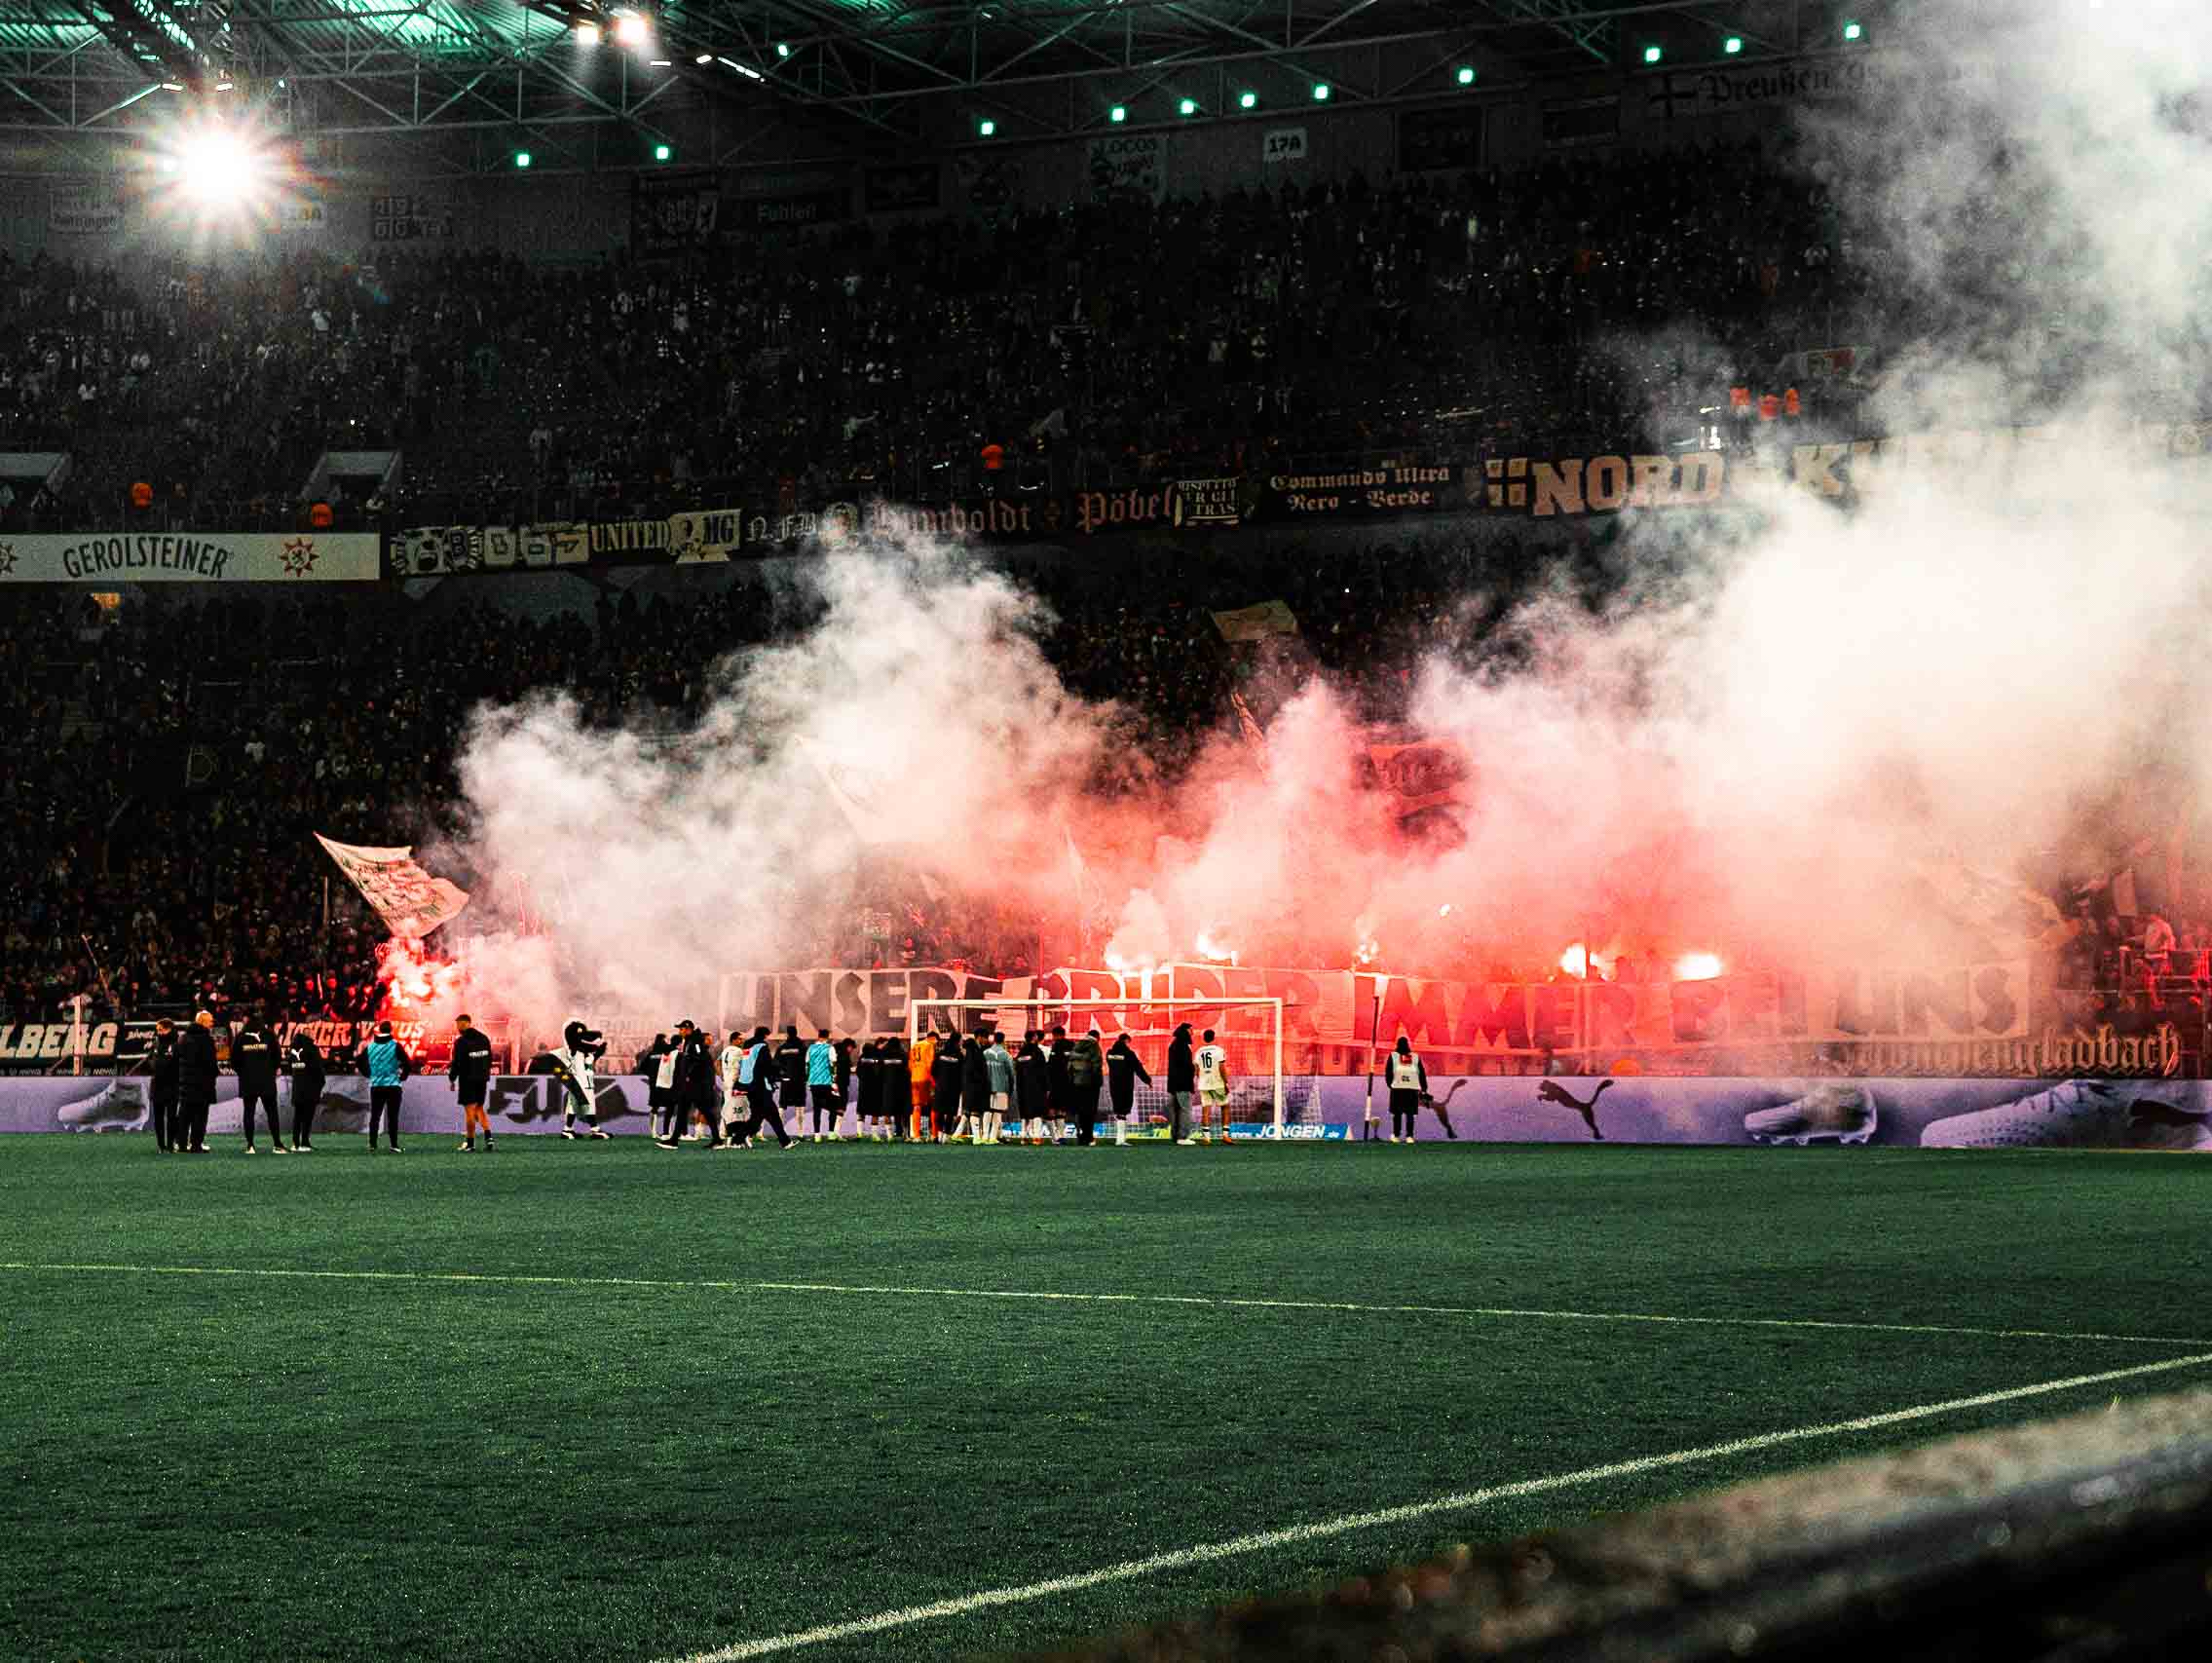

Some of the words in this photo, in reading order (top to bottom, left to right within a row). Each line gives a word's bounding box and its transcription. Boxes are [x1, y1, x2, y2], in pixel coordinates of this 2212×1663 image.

[1266, 136, 1296, 153] 17A
[1270, 471, 1387, 491] Commando
[1395, 467, 1449, 484] Ultra
[1532, 452, 1724, 515] NORD
[1075, 484, 1173, 535] Pöbel
[1287, 495, 1339, 511] Nero
[1367, 489, 1434, 508] Verde
[590, 520, 670, 552] UNITED
[62, 536, 229, 578] GEROLSTEINER
[724, 968, 998, 1035] UNSERE
[1355, 975, 1637, 1049] IMMER
[1836, 967, 2018, 1036] UNS
[1201, 1052, 1212, 1069] 16
[1256, 1124, 1326, 1139] JONGEN
